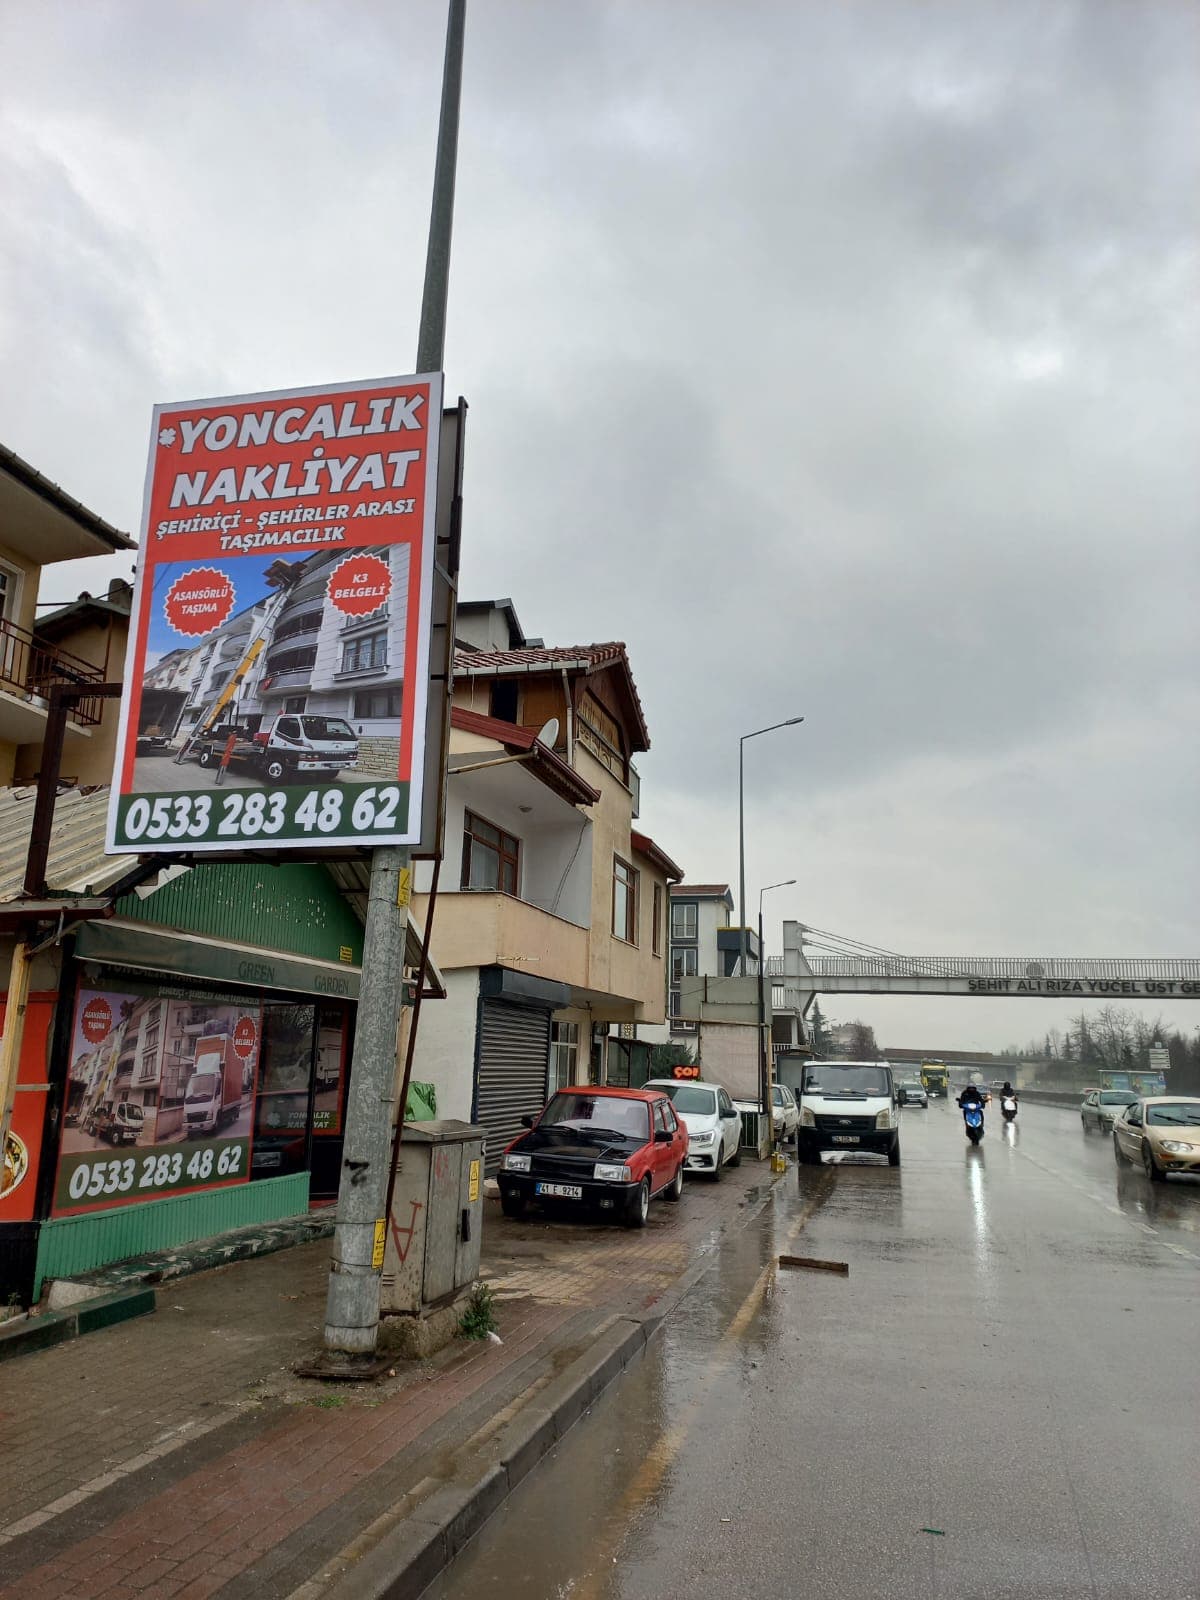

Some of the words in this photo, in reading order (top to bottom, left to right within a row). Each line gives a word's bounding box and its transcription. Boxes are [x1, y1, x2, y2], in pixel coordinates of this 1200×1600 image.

[178, 393, 425, 454] YONCALIK
[169, 447, 420, 509] NAKLİYAT
[156, 510, 241, 539] ŞEHİRİÇİ
[256, 504, 349, 531] ŞEHİRLER
[352, 498, 416, 518] ARASI
[219, 526, 345, 553] TAŞIMACILIK
[334, 583, 386, 599] BELGELİ
[352, 573, 369, 584] K3
[173, 585, 229, 602] ASANSÖRLÜ
[181, 602, 218, 617] TAŞIMA
[124, 795, 212, 840] 0533
[216, 791, 287, 836] 283
[294, 788, 344, 833] 48
[352, 786, 400, 831] 62
[238, 961, 275, 982] GREEN
[314, 975, 349, 993] GARDEN
[1046, 980, 1083, 992] RIZA
[69, 1158, 136, 1199] 0533
[139, 1152, 183, 1188] 283
[186, 1149, 214, 1180] 48
[217, 1145, 242, 1176] 62
[541, 1183, 549, 1193] 41
[553, 1185, 558, 1194] E
[562, 1186, 579, 1197] 9214
